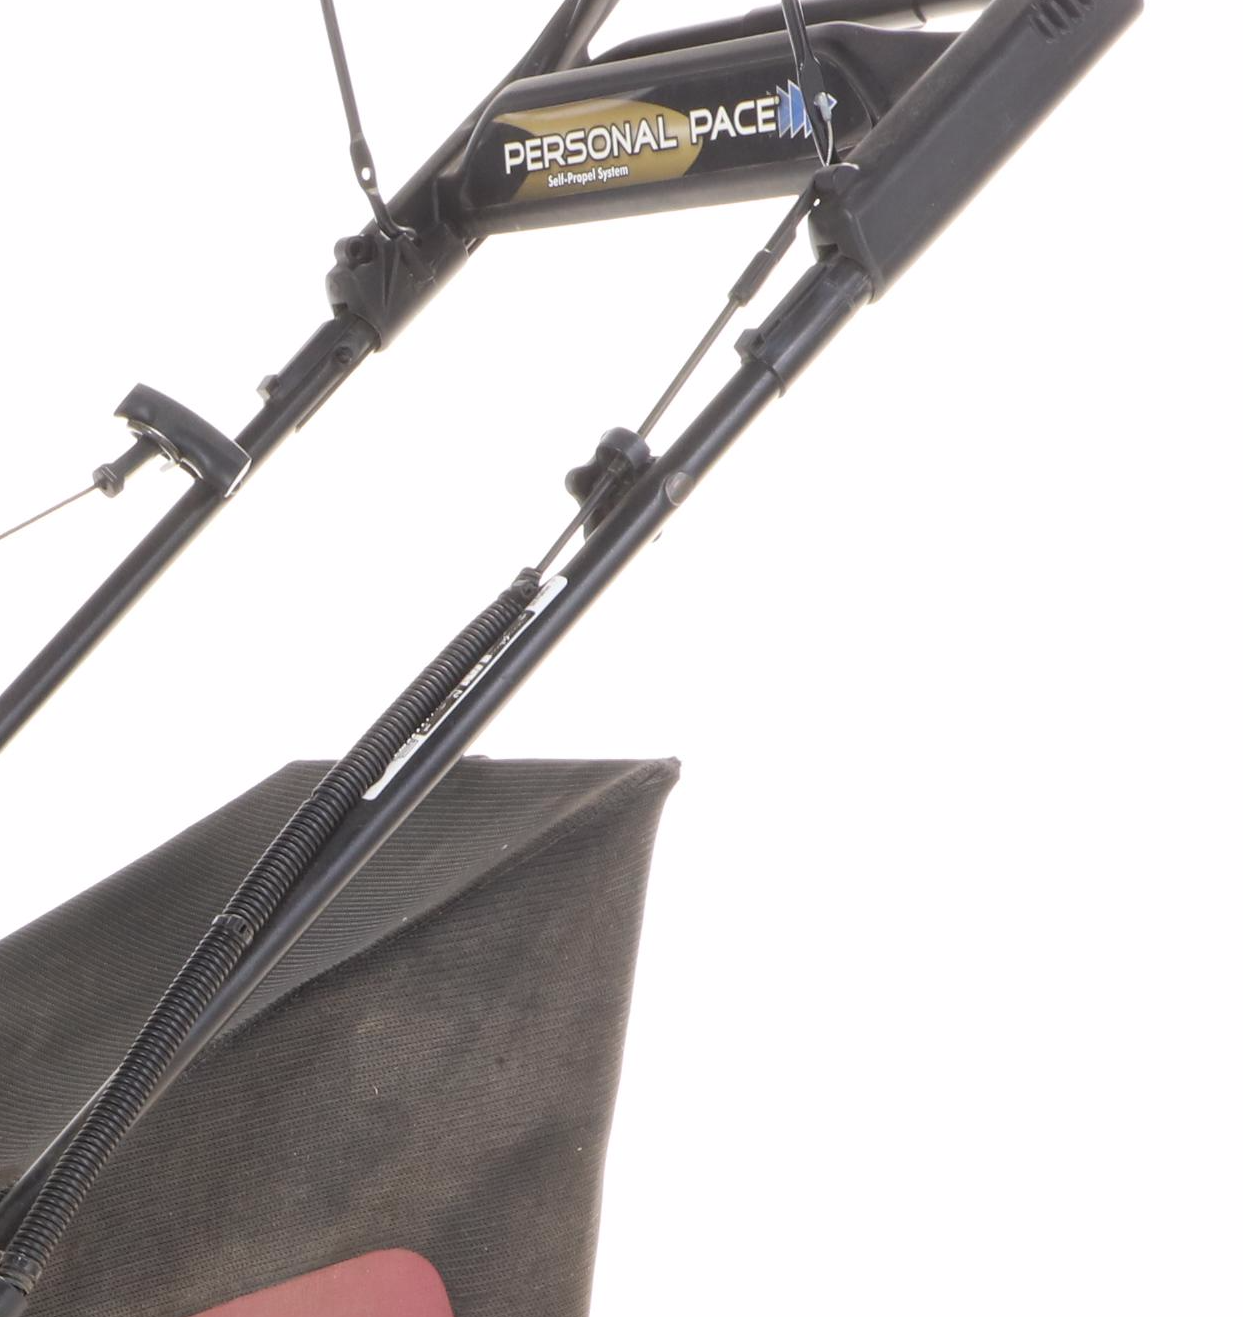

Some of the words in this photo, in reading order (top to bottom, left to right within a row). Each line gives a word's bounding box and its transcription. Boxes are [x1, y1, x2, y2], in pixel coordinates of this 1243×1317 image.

[504, 115, 677, 175] PERSONAL
[689, 96, 777, 143] PACE
[548, 167, 596, 188] Self-Propel
[598, 165, 629, 182] System
